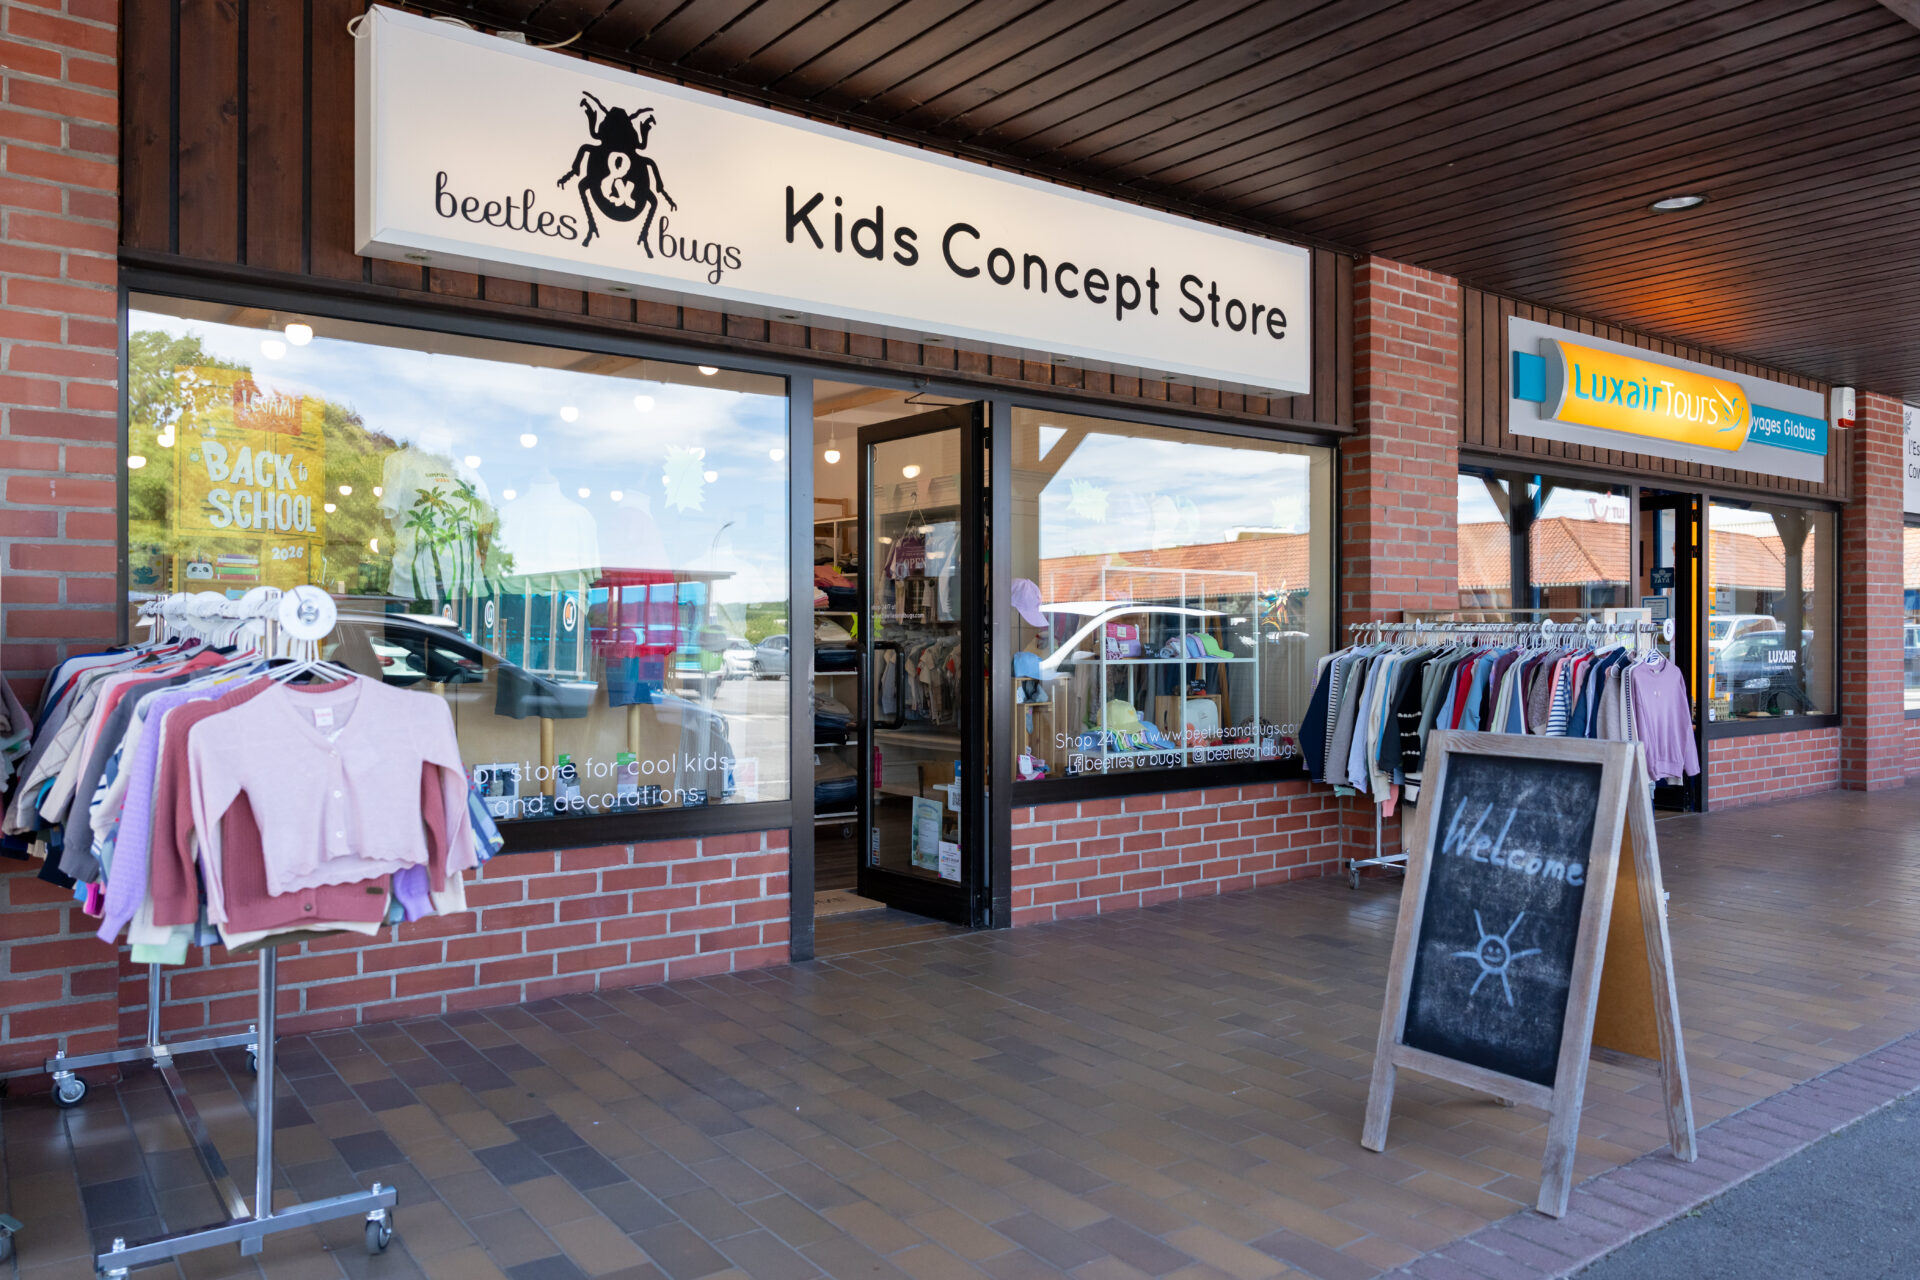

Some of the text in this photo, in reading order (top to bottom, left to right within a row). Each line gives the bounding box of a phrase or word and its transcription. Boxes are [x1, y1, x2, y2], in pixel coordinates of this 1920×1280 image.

[435, 171, 578, 241] beetles
[658, 216, 742, 285] bugs
[786, 185, 1288, 340] Kids Concept Store
[1752, 415, 1816, 442] yages Globus
[201, 440, 308, 490] BACK to
[207, 488, 317, 532] SCHOOL
[271, 545, 304, 561] 2026
[1768, 650, 1797, 664] LUXAIR
[1055, 731, 1092, 750] Shop
[1097, 730, 1127, 746] 24/7
[1207, 745, 1298, 761] beetlesandbugs
[510, 758, 576, 783] store
[585, 757, 619, 778] for
[627, 753, 676, 776] cool
[1084, 753, 1134, 771] beetles
[1149, 751, 1182, 768] bugs
[494, 791, 543, 817] and
[1442, 796, 1585, 887] Welcome
